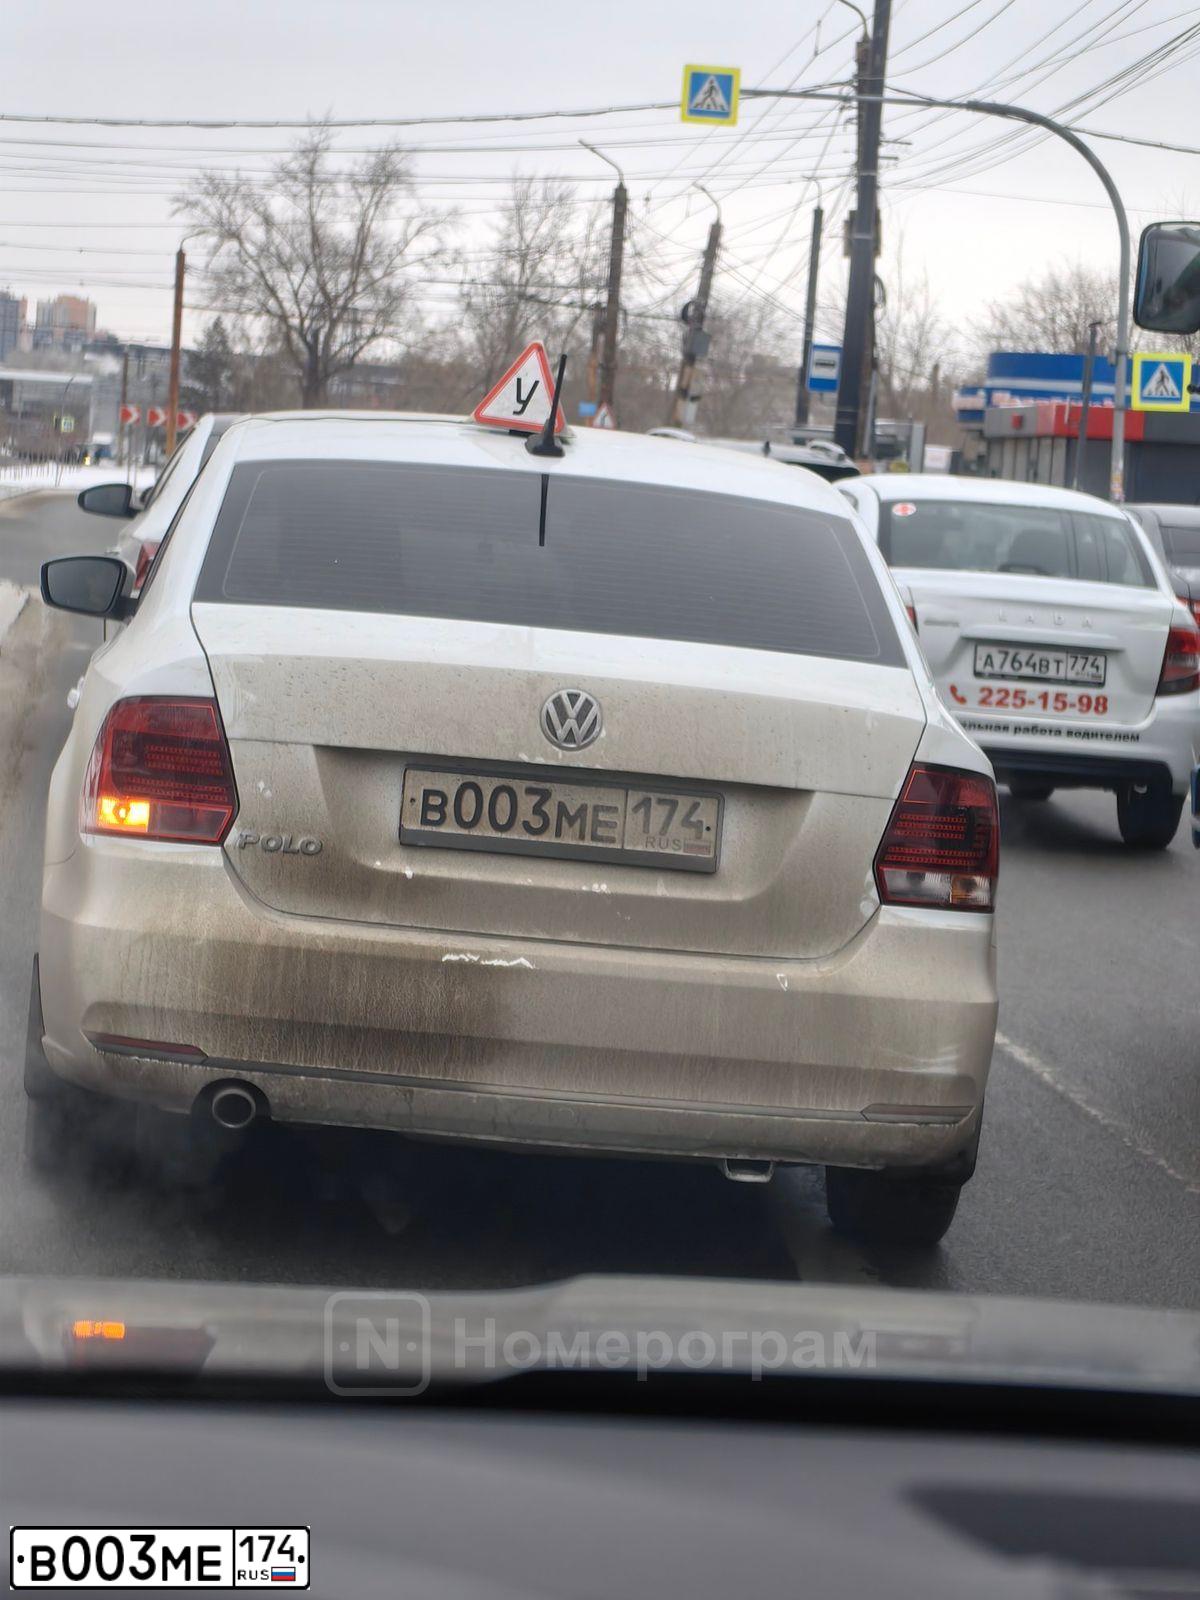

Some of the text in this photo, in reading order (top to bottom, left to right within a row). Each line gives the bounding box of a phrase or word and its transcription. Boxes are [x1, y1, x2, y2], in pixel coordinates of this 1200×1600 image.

[978, 686, 1109, 715] 225-15-98
[1014, 725, 1062, 736] работа
[1066, 728, 1140, 742] водителем
[420, 781, 704, 844] В003МЕ 174
[237, 830, 323, 856] POLO
[645, 836, 682, 851] RUS
